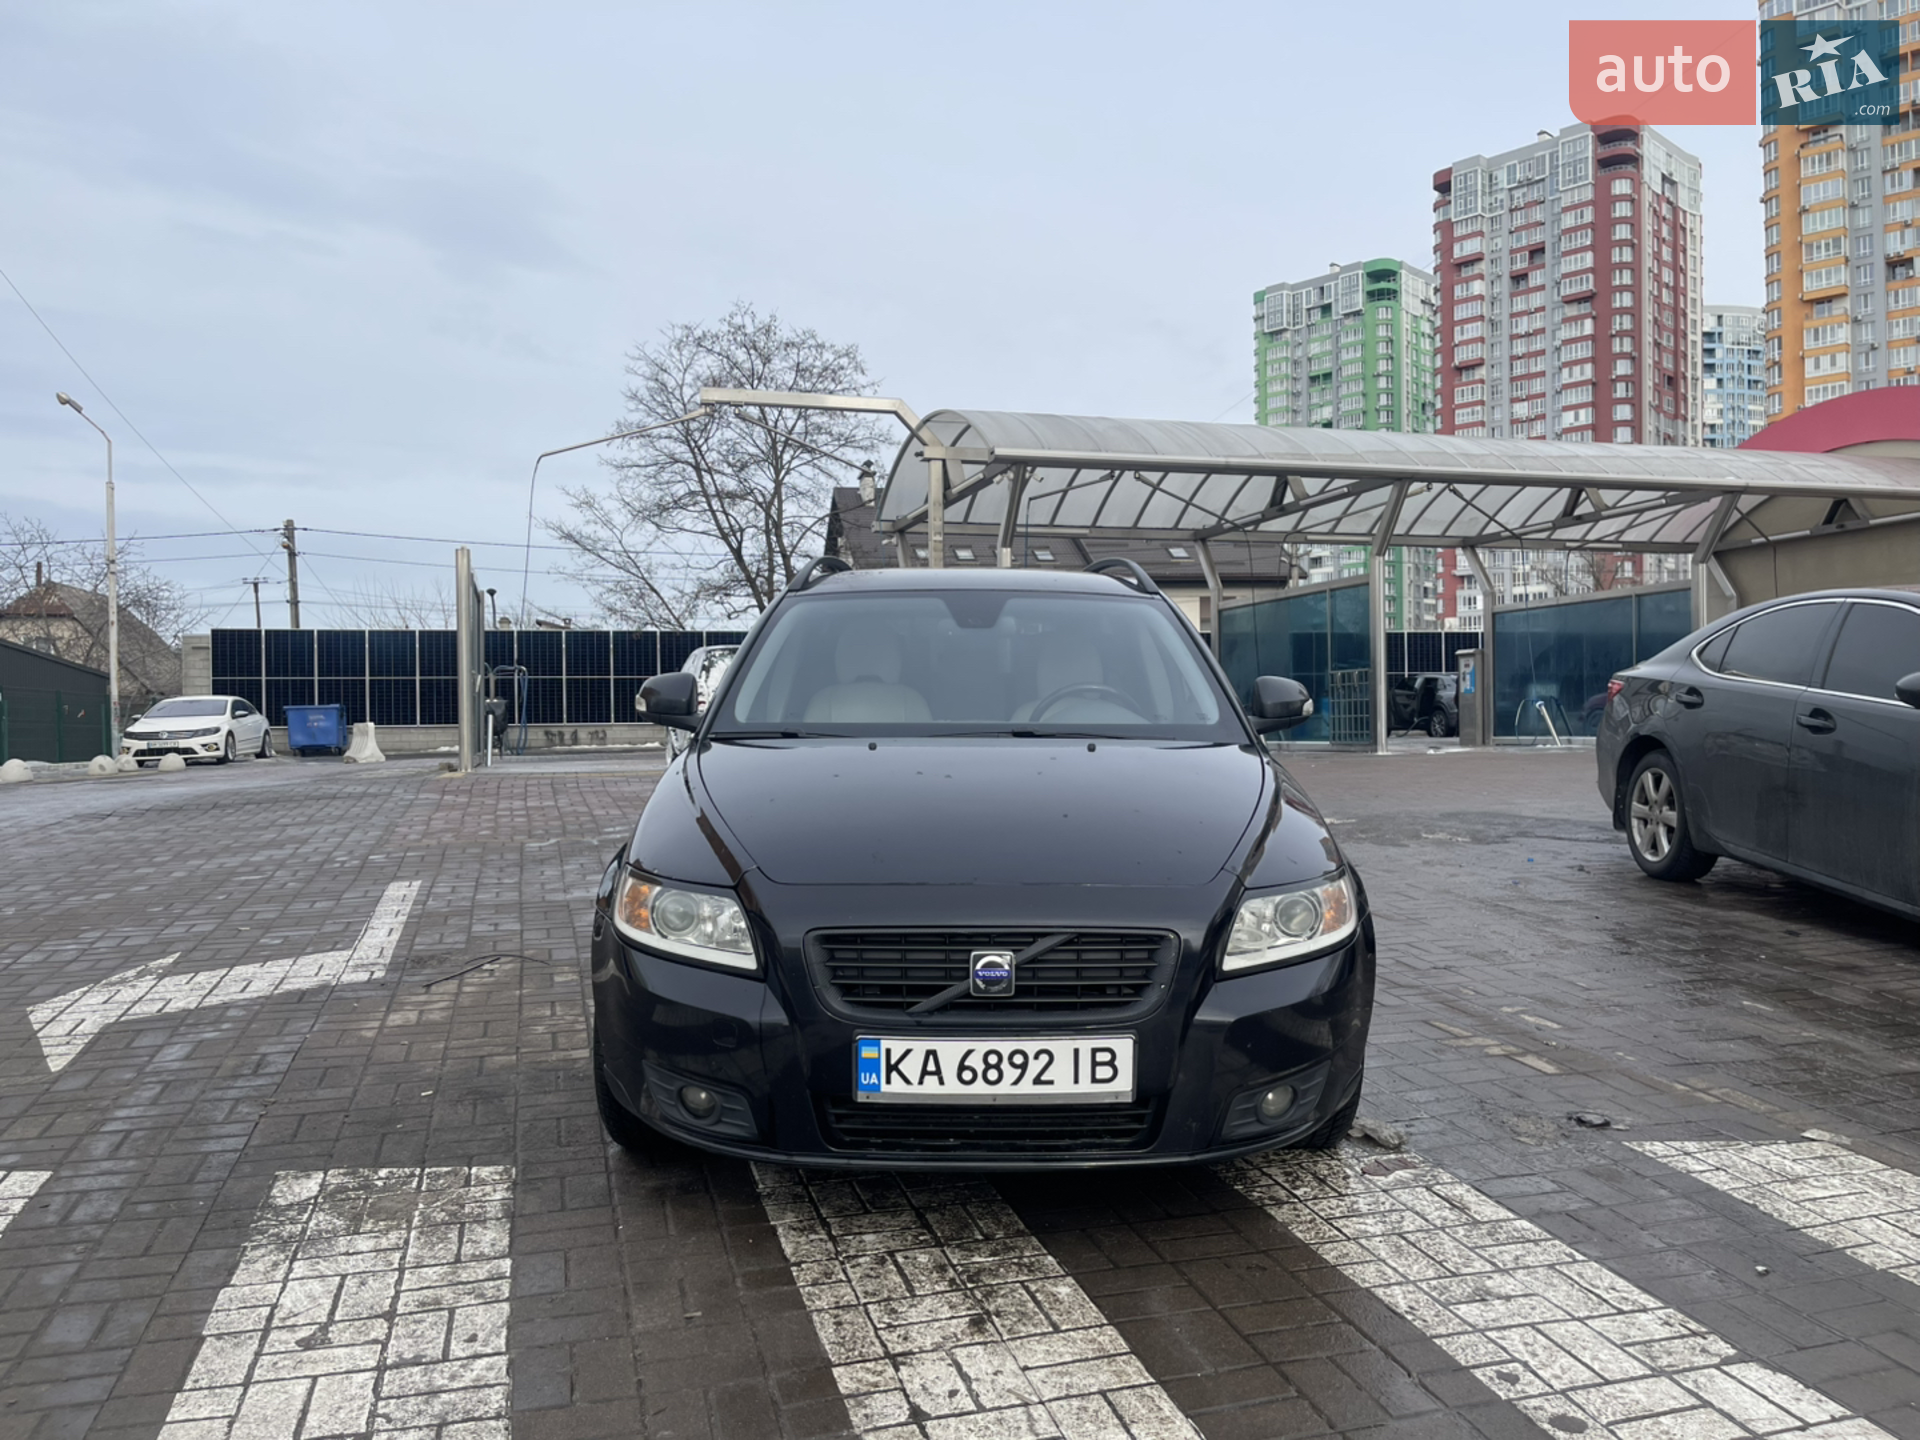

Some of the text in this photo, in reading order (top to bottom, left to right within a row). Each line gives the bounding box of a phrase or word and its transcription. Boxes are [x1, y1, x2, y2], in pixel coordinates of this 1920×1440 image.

[861, 1072, 879, 1085] UA
[884, 1047, 1119, 1086] KA 6892 IB
